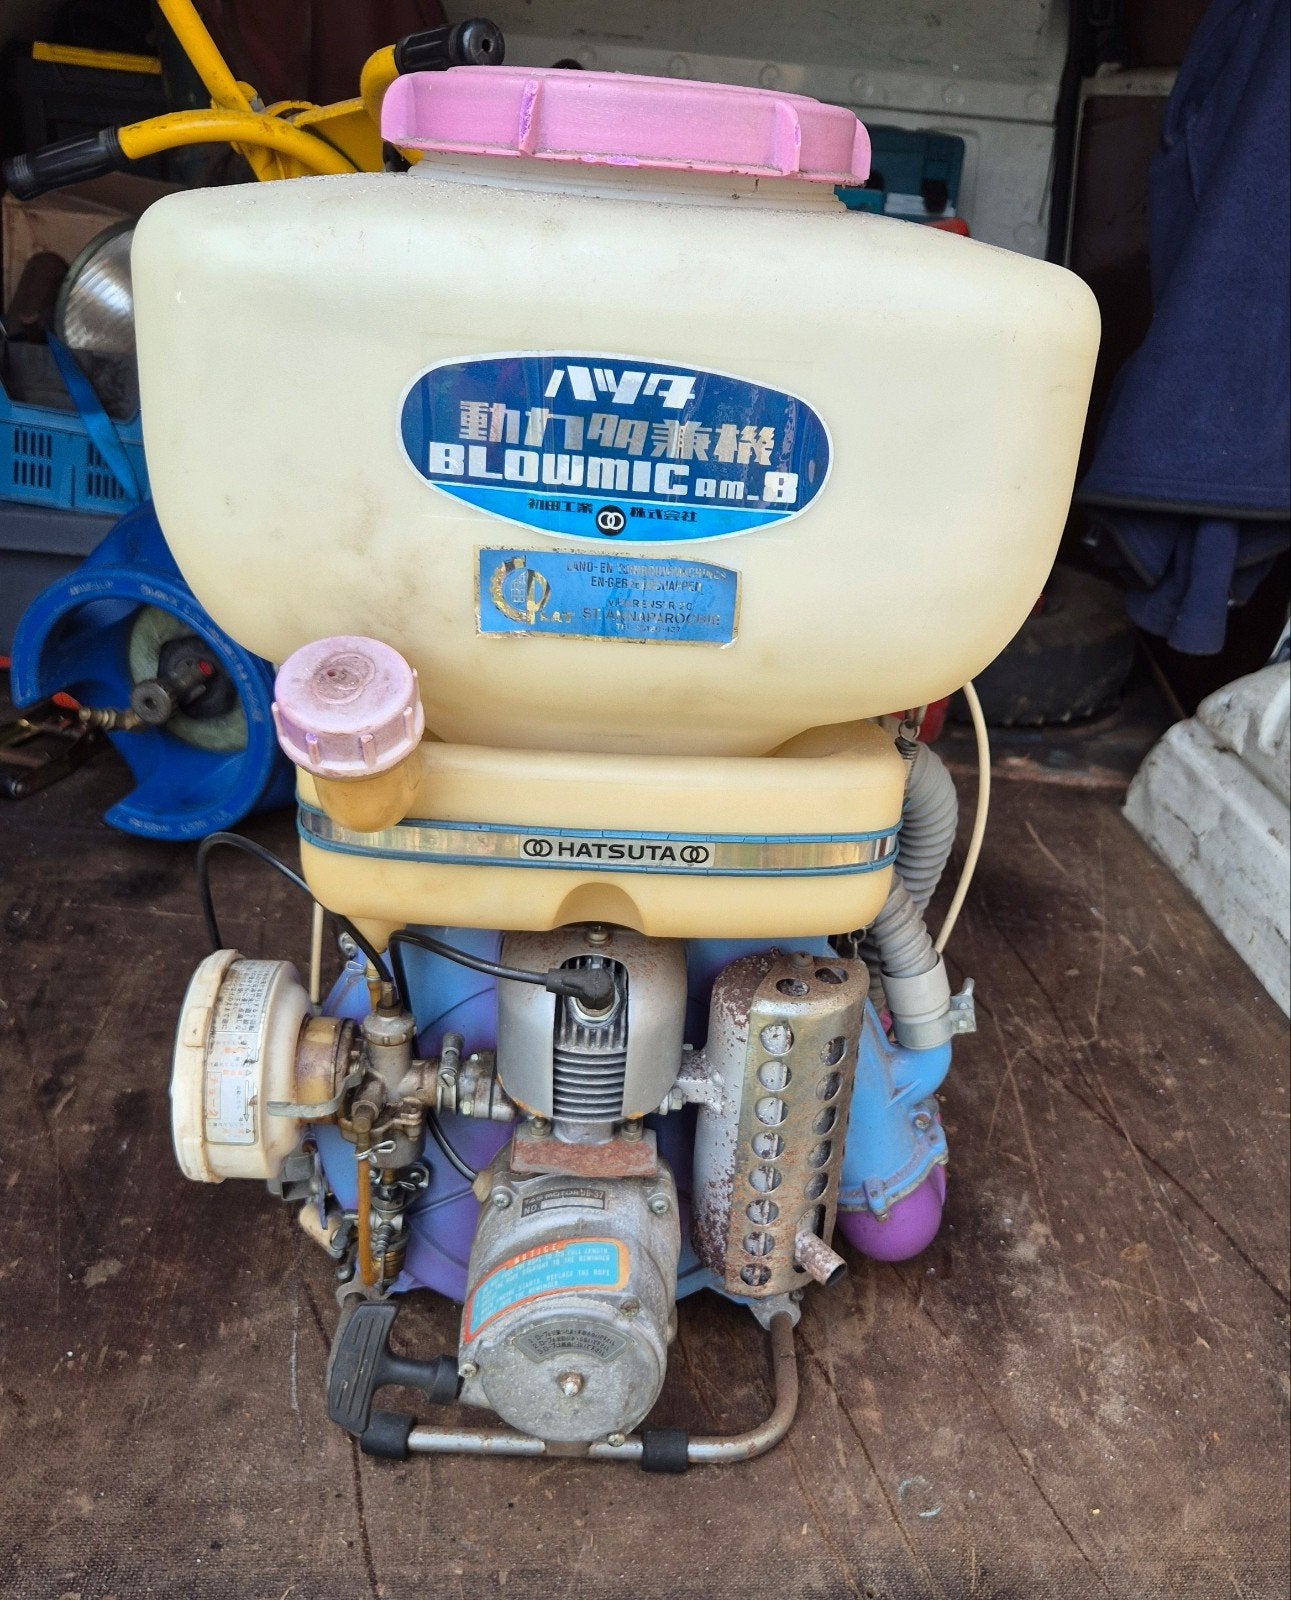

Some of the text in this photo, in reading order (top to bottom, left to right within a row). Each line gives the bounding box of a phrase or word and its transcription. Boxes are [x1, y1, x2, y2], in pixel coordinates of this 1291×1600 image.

[527, 498, 698, 523] 初田工業 株式会社
[558, 841, 677, 862] HATSUTA
[514, 1243, 559, 1265] NOTICE
